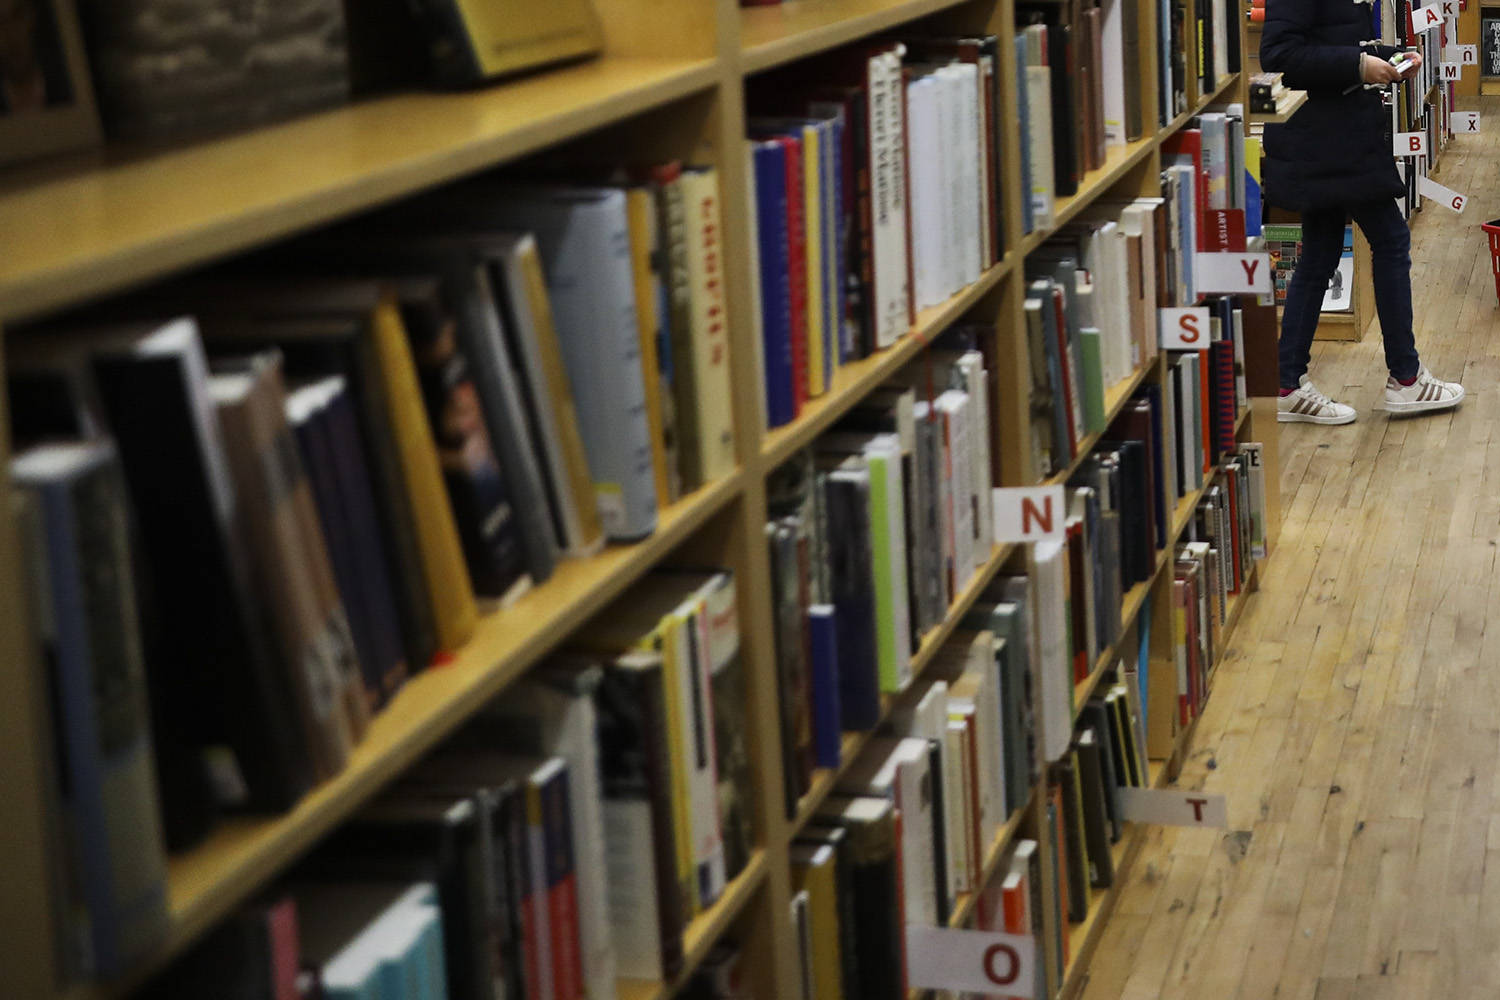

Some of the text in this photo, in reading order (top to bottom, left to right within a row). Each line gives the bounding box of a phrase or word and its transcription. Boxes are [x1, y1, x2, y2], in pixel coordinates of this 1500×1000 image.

[1426, 9, 1438, 25] A
[1443, 3, 1452, 14] K
[1445, 66, 1456, 78] M
[1469, 120, 1475, 130] X
[1409, 136, 1421, 151] B
[1452, 197, 1463, 210] G
[1218, 211, 1228, 244] ARTIST
[1241, 260, 1258, 285] Y
[1180, 315, 1199, 343] S
[1251, 450, 1260, 467] E
[1022, 496, 1052, 534] N
[1187, 799, 1207, 821] T
[983, 944, 1020, 985] O
